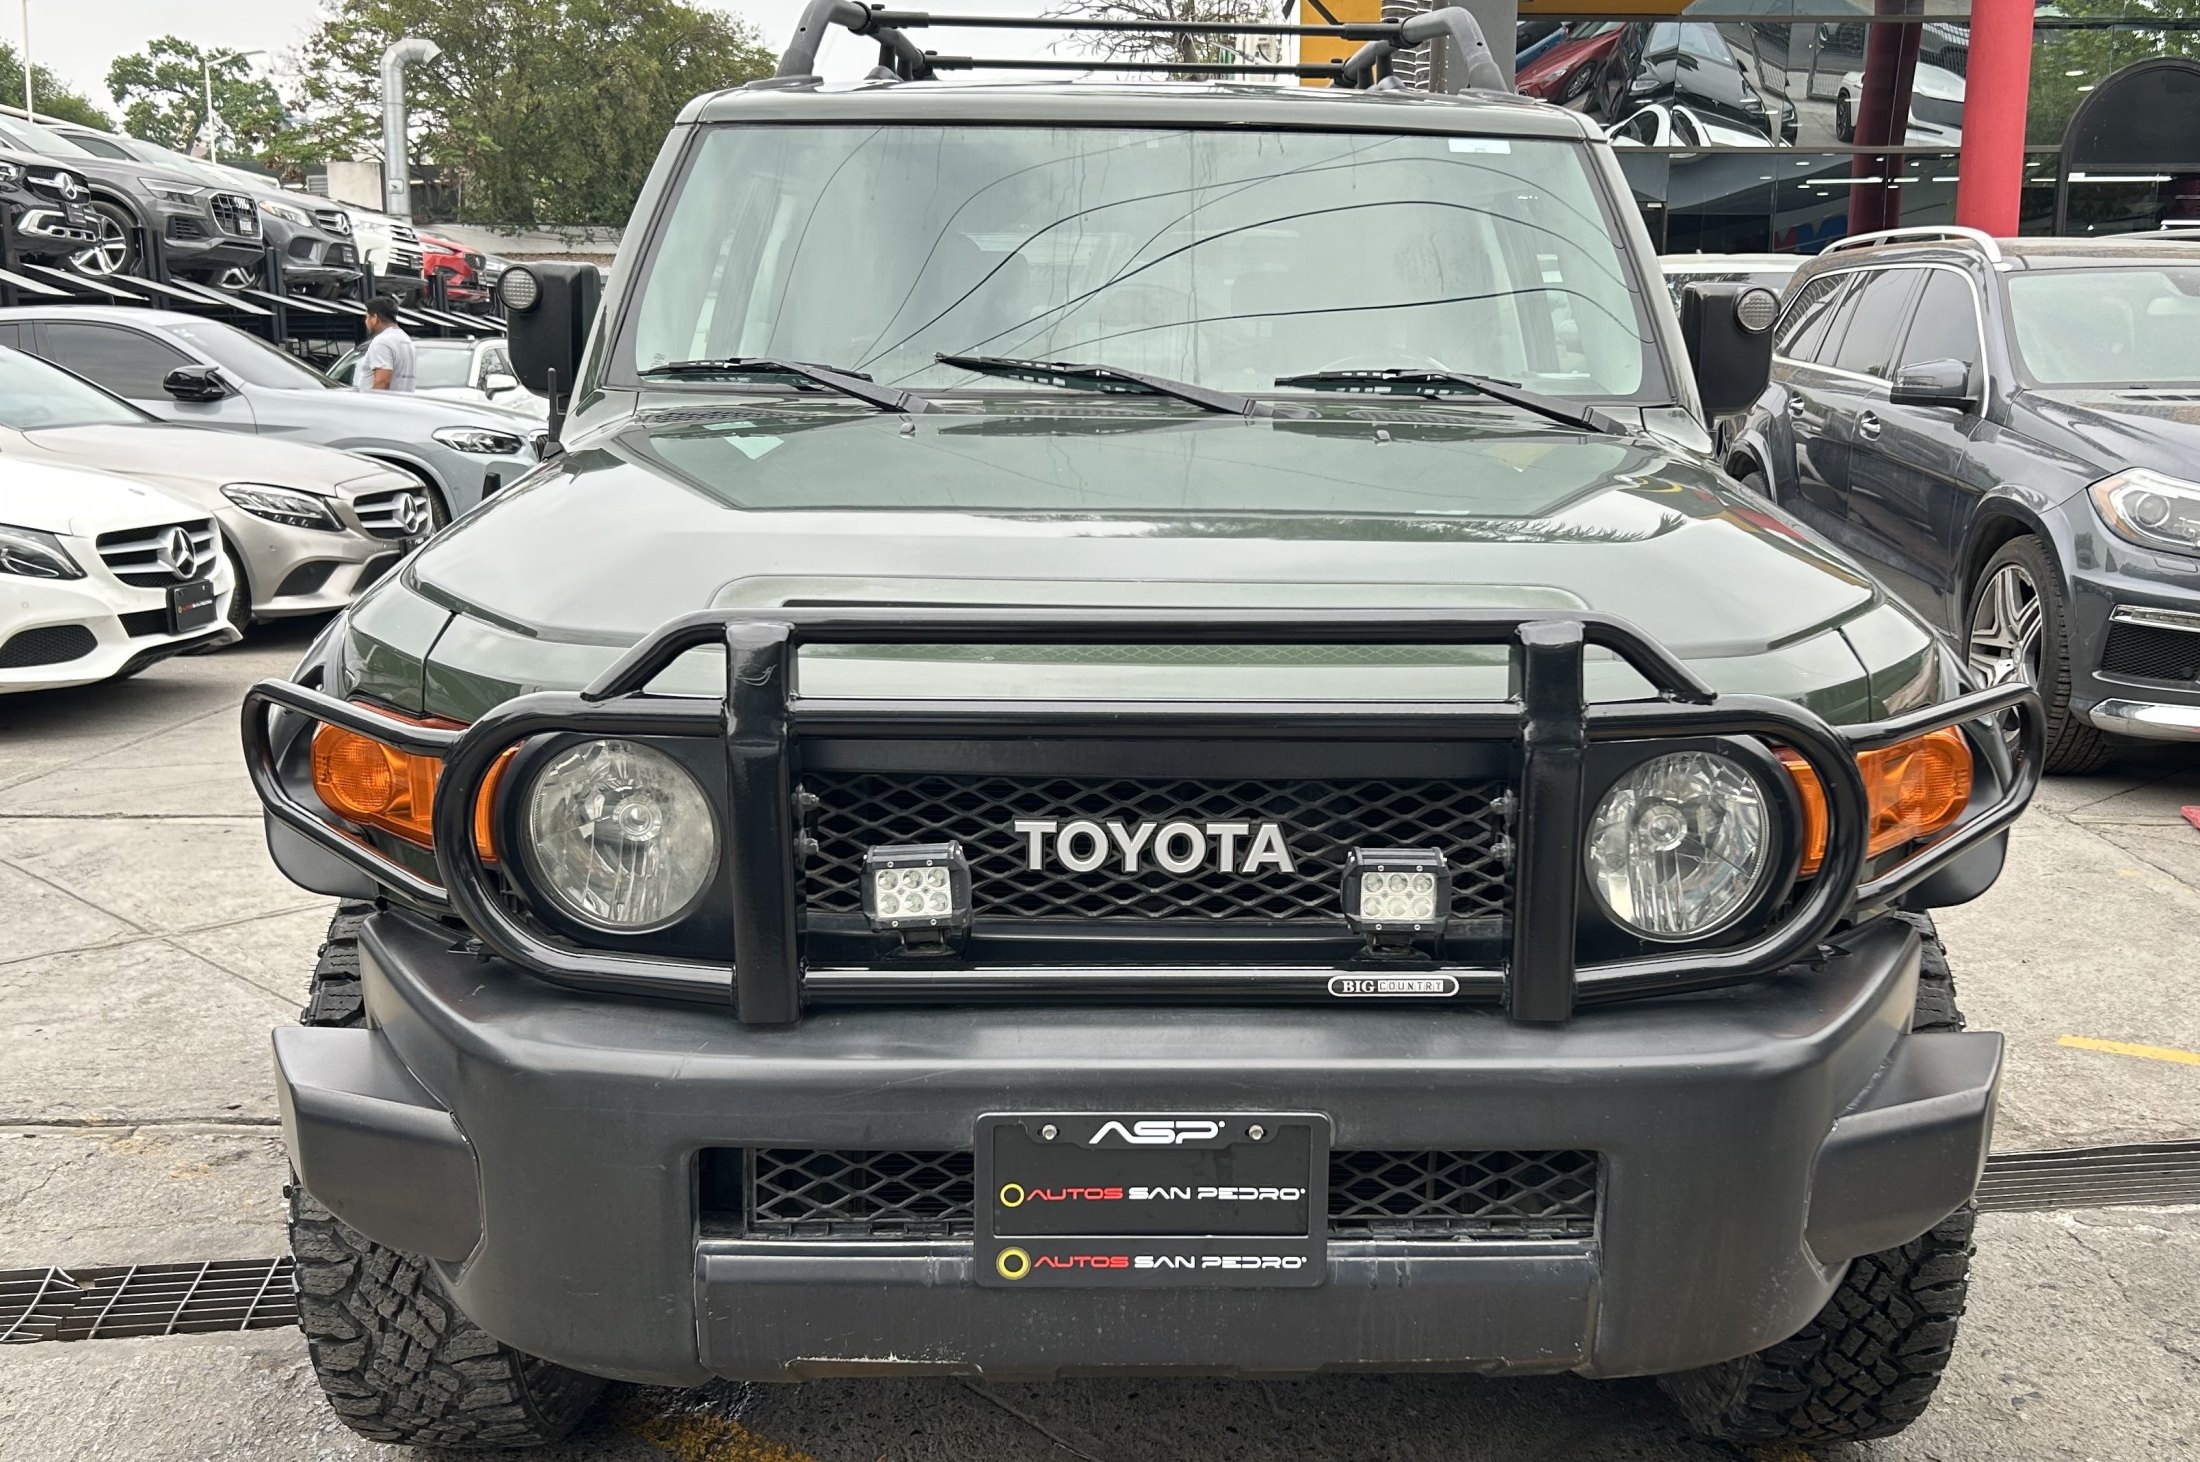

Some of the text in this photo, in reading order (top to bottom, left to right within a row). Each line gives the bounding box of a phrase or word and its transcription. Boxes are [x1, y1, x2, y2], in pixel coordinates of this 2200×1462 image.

[1013, 819, 1295, 874] TOYOTA
[1342, 980, 1442, 992] BIG COUNTRY
[1088, 1120, 1219, 1145] ASP
[1026, 1186, 1301, 1201] AUTOS SAN PEDRO
[1034, 1255, 1303, 1269] AUTOS SAN PEDRO
